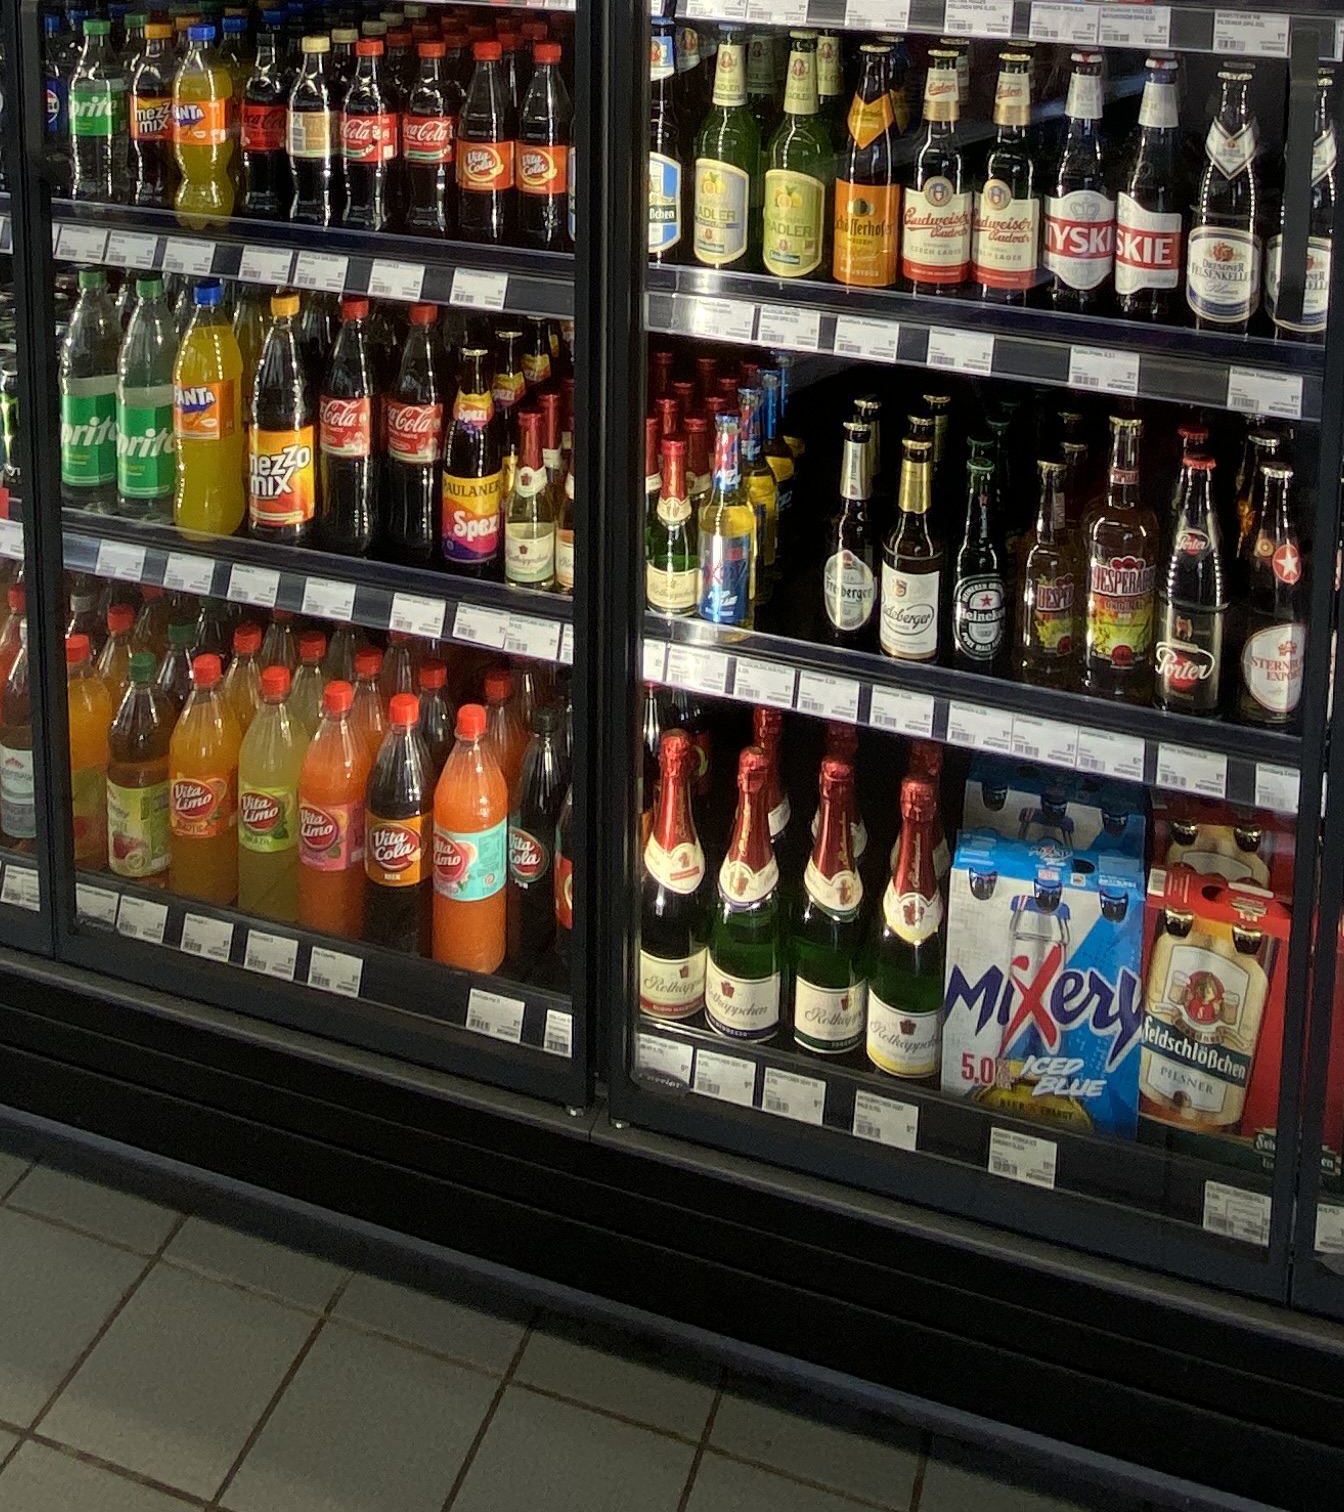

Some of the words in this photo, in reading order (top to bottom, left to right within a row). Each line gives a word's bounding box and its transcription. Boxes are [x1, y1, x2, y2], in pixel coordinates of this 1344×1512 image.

[139, 116, 169, 136] mix
[464, 148, 489, 164] Vita
[521, 152, 545, 166] Vita
[466, 157, 496, 175] Cola
[522, 162, 549, 176] Cola
[698, 208, 737, 223] ADLER
[458, 402, 487, 421] Spezi
[1155, 645, 1215, 684] Porter
[174, 784, 204, 803] Vita
[174, 793, 213, 810] Limo
[241, 795, 270, 814] Vita
[242, 805, 279, 822] Limo
[374, 830, 408, 850] Vita
[375, 843, 414, 863] Cola
[1142, 1014, 1247, 1081] Feldschlößchen
[1020, 1055, 1085, 1079] ICED
[1032, 1075, 1108, 1099] BLUE
[1159, 1065, 1215, 1096] PILSNER
